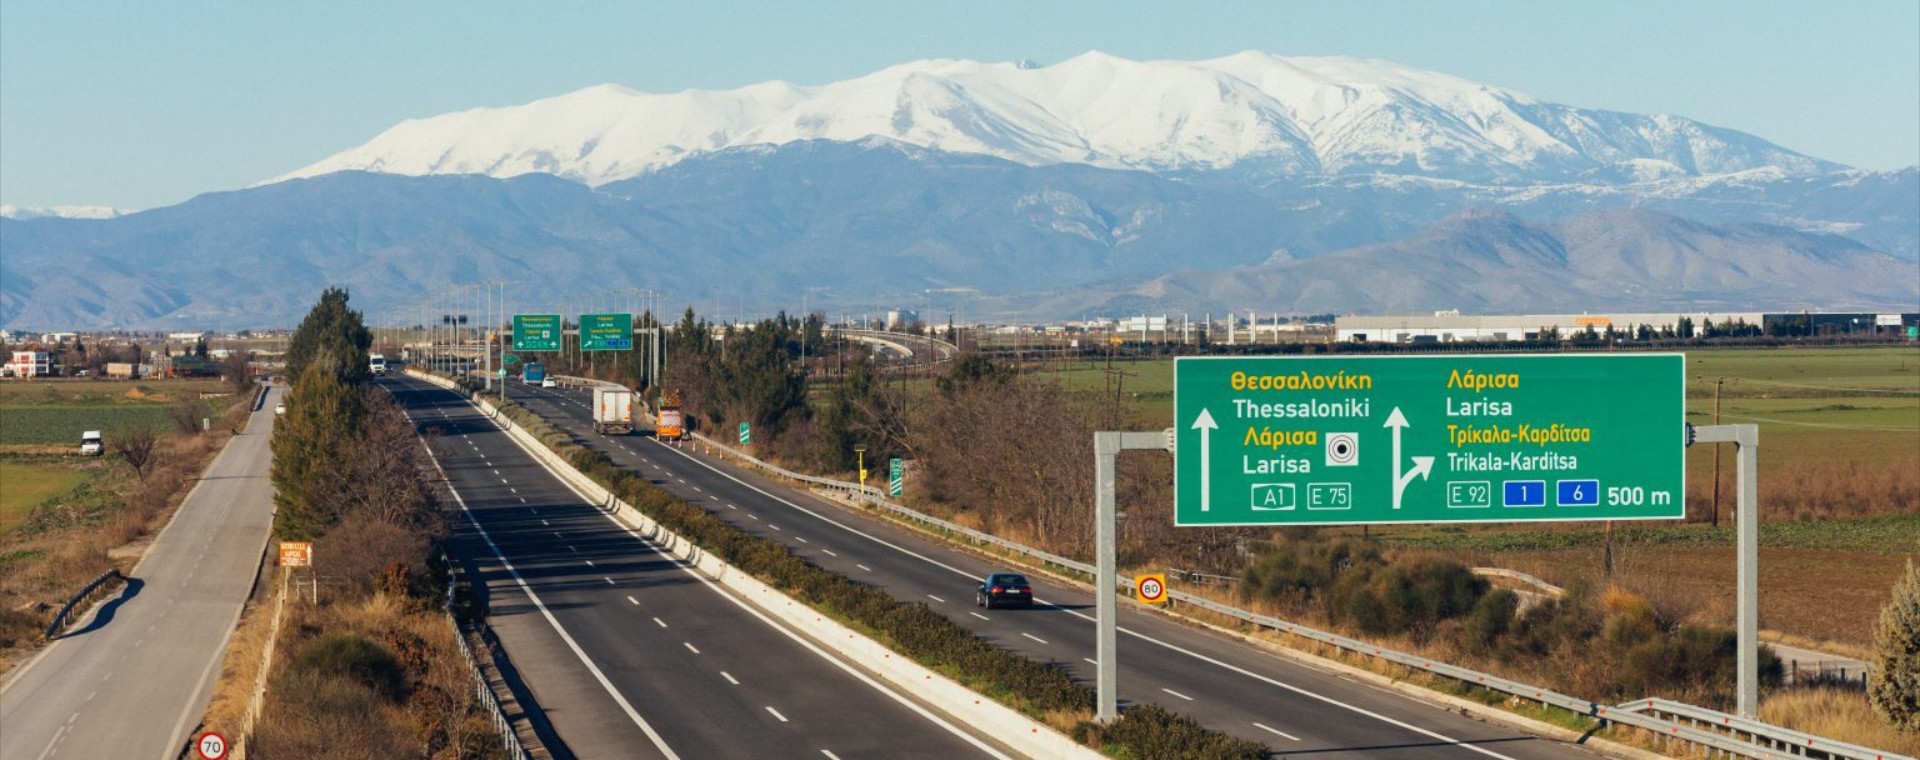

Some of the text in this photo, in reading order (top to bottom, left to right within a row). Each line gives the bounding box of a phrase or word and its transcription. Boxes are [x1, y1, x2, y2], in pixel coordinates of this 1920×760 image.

[1231, 370, 1372, 391] Θεσσαλονίκη
[1447, 370, 1520, 393] Λάρισα
[1232, 398, 1370, 418] Thessaloniki
[1446, 397, 1512, 416] Larisa
[1243, 426, 1317, 451] Λάρισα
[1447, 424, 1591, 448] Τρίκαλα-Καρδίτσα
[1243, 455, 1311, 474] Larisa
[1447, 451, 1577, 471] Trikala-Karditsa
[1264, 487, 1284, 505] A1
[1312, 487, 1347, 505] E 75
[1452, 486, 1486, 503] E 92
[1520, 485, 1528, 502] 1
[1573, 485, 1583, 501] 6
[1608, 486, 1671, 506] 500 m
[1145, 584, 1158, 593] 80
[204, 741, 221, 753] 70
